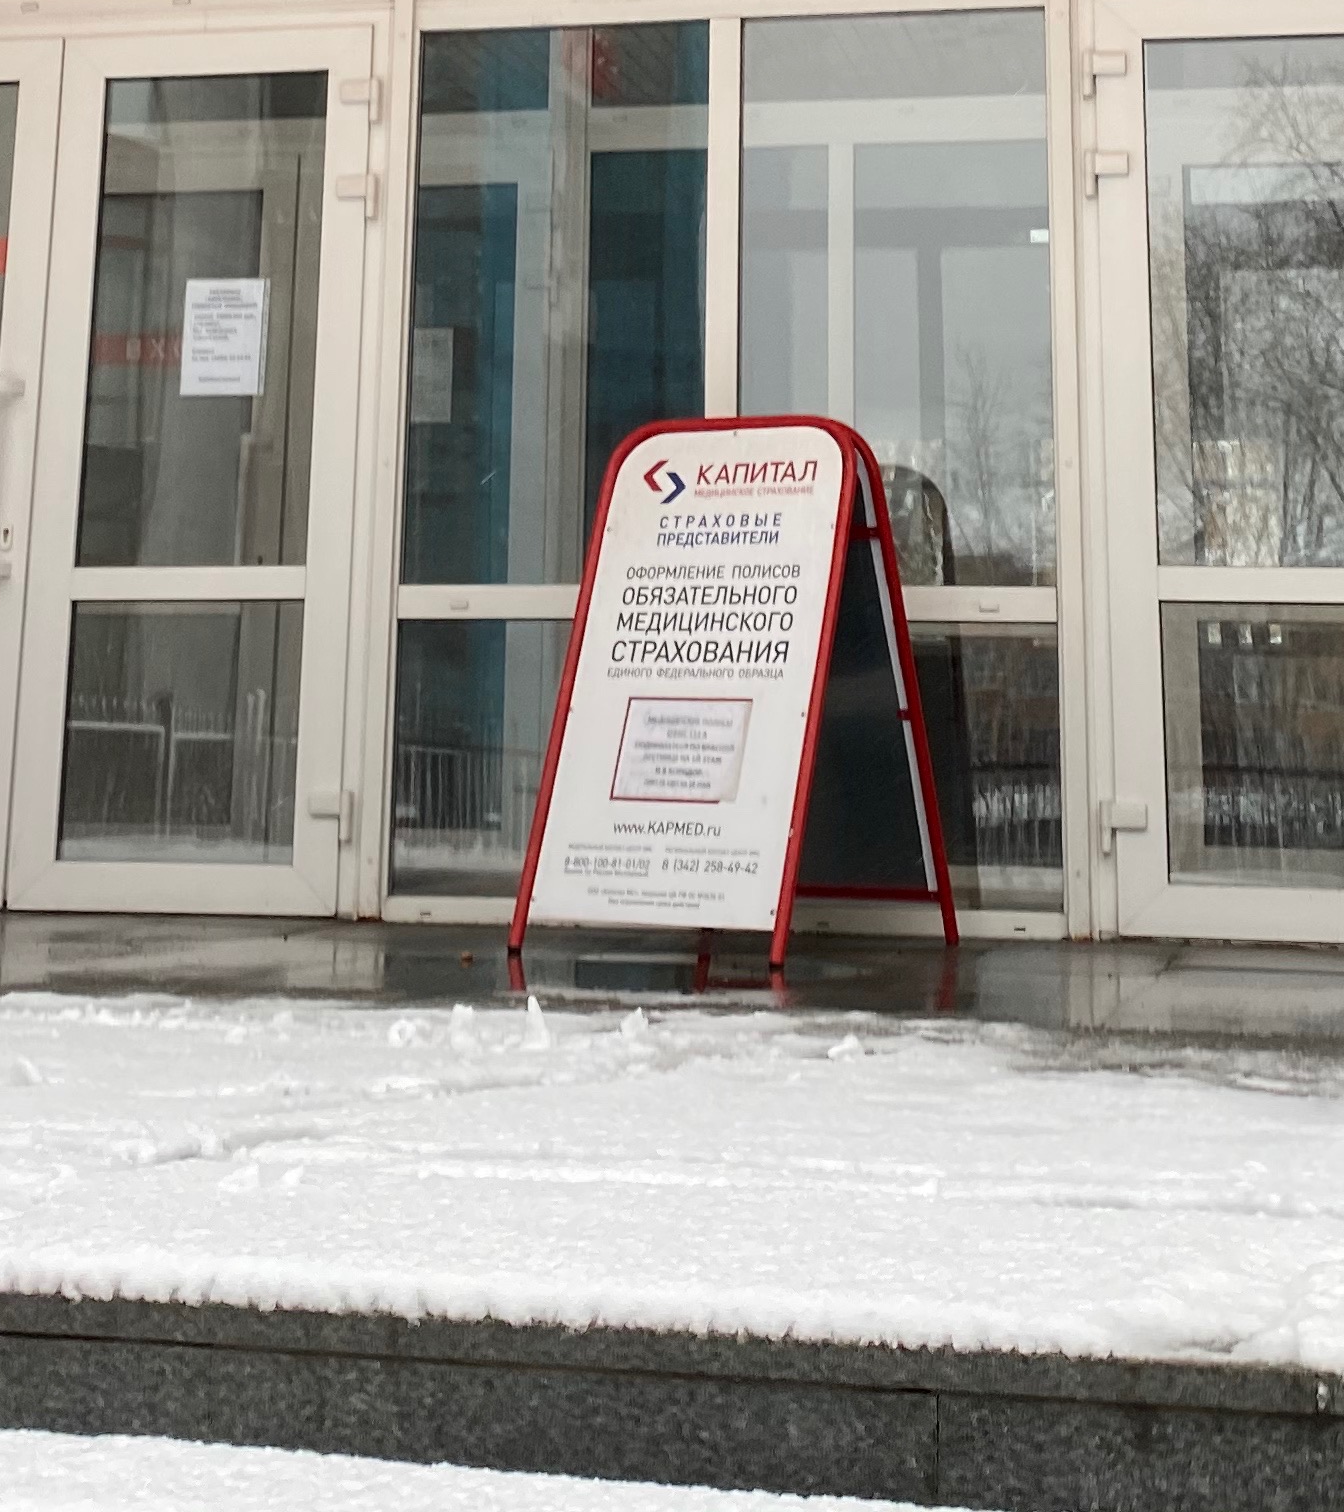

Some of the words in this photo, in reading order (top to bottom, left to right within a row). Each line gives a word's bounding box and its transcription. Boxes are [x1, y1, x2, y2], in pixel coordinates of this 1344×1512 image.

[696, 460, 818, 486] КАПИТАЛ
[659, 512, 782, 529] СТРАХОВЫЕ
[657, 530, 779, 548] ПРЕДСТАВИТЕЛИ
[626, 564, 725, 580] ОФОРМЛЕНИЕ
[732, 563, 801, 580] ПОЛИСОВ
[622, 585, 798, 606] ОБЯЗАТЕЛЬНОГО
[616, 611, 794, 636] МЕДИЦИНСКОГО
[611, 640, 790, 664] СТРАХОВАНИЯ
[607, 667, 653, 679] ЕДИНОГО
[656, 667, 735, 679] ФЕДЕРАЛЬНОГО
[738, 667, 784, 680] ОБРАЗЦА
[613, 821, 722, 838] www.KAPMED.ru
[661, 858, 669, 871] 8
[673, 857, 700, 873] (342)
[703, 859, 759, 875] 258-49-42
